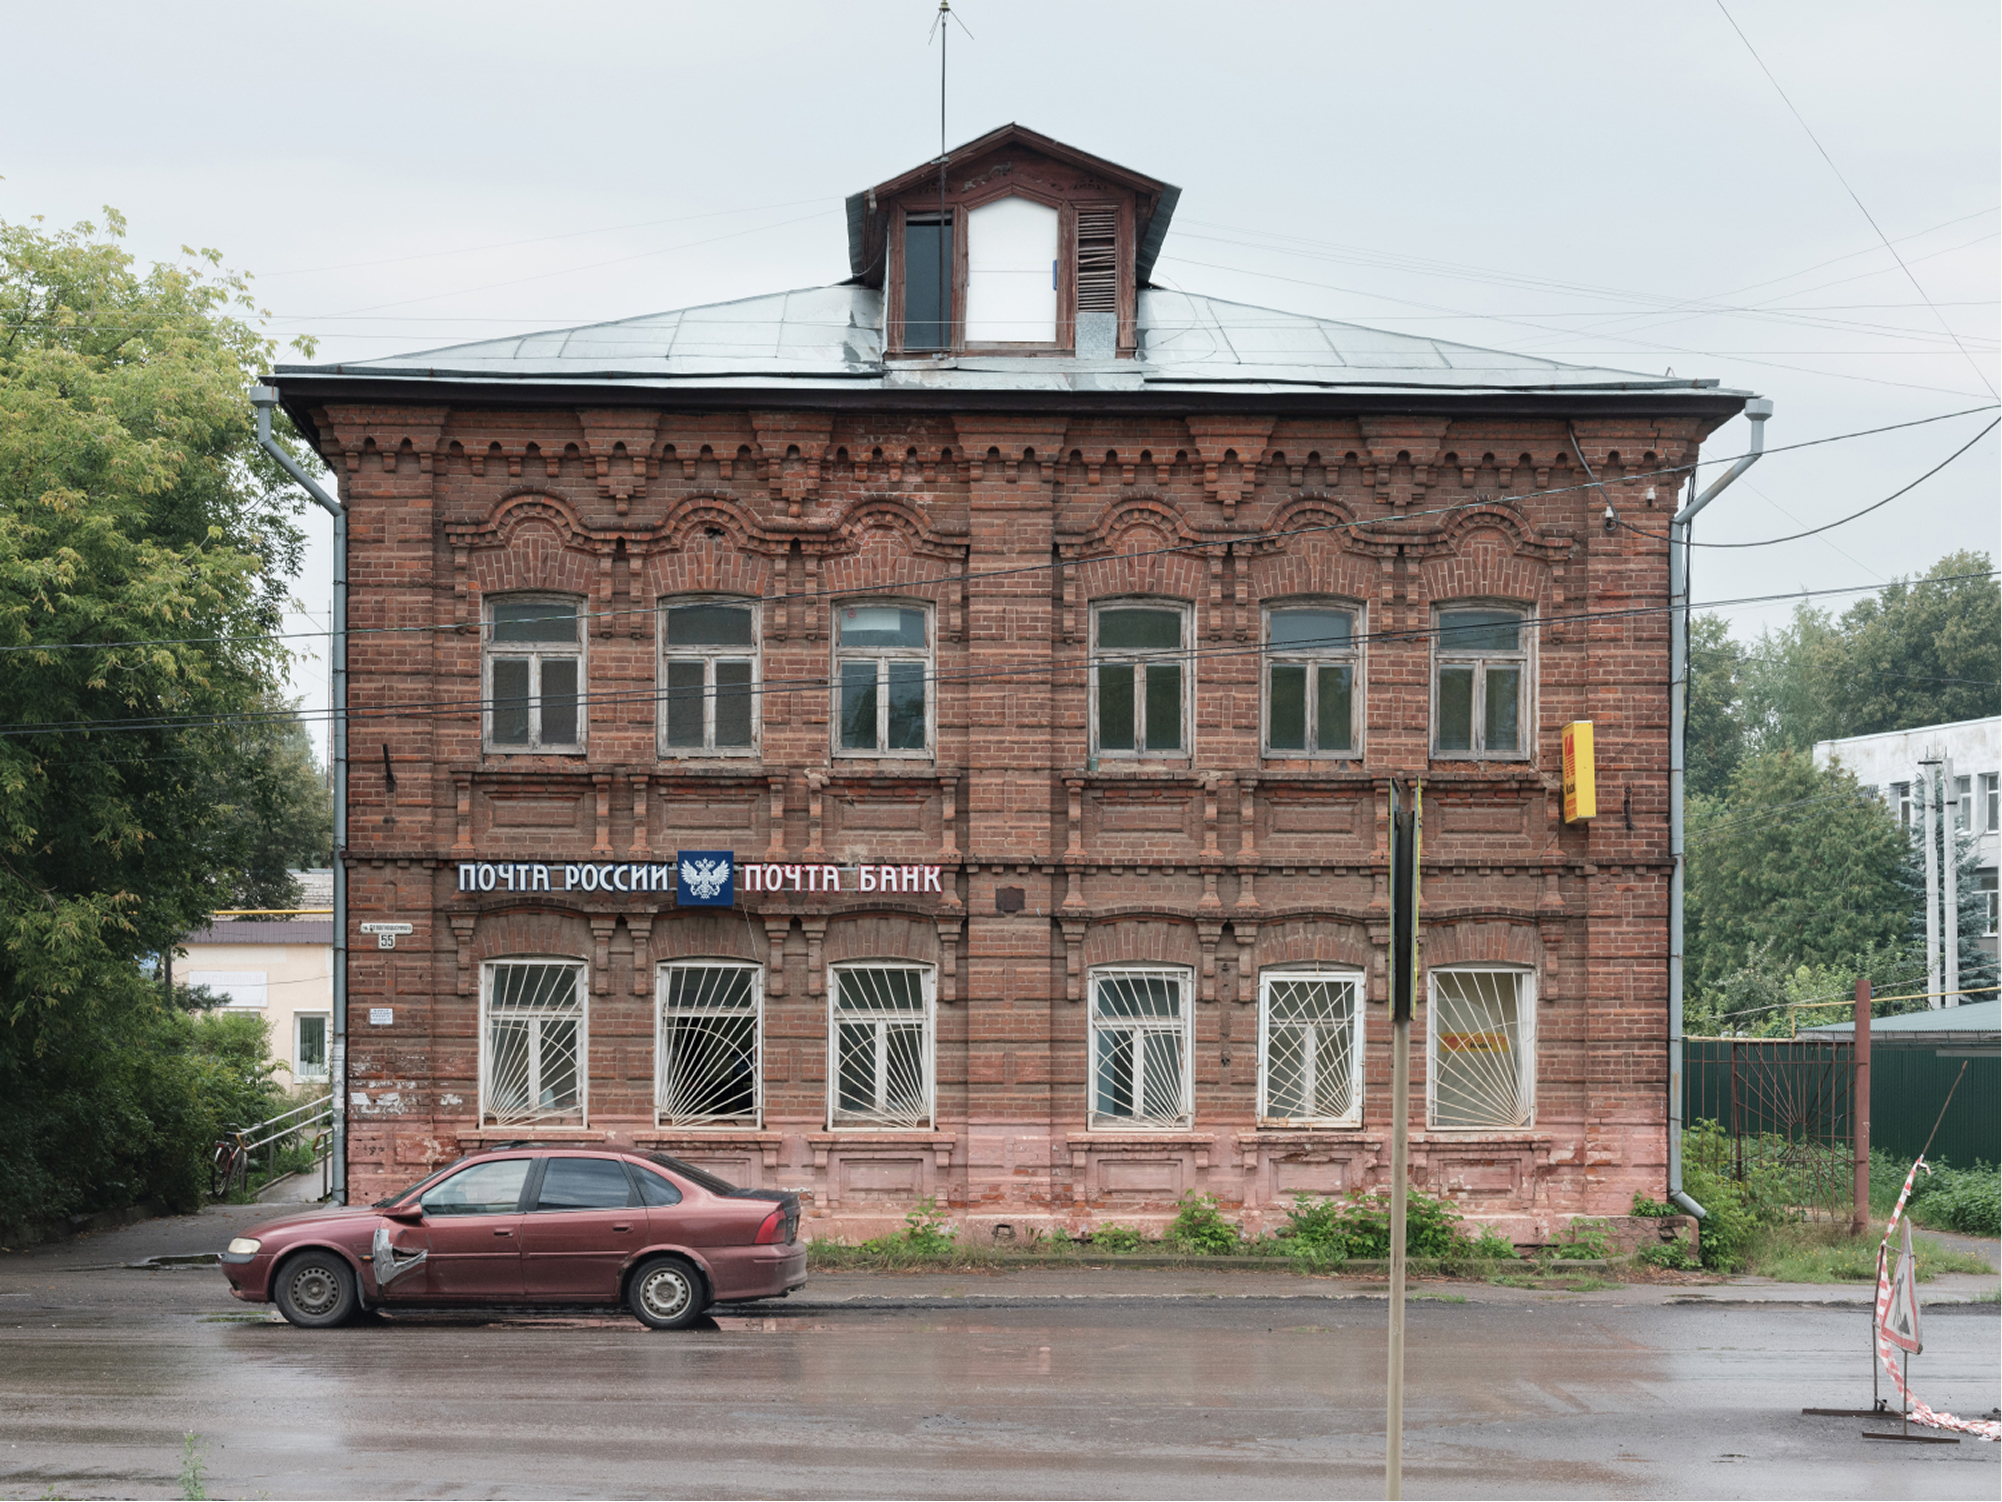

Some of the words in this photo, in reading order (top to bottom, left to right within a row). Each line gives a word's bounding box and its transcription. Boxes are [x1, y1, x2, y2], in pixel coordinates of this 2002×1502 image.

[458, 863, 550, 892] ПОЧТА
[564, 862, 669, 892] РОССИИ
[743, 864, 841, 893] ПОЧТА
[858, 864, 943, 893] БАНК
[381, 934, 394, 947] 55
